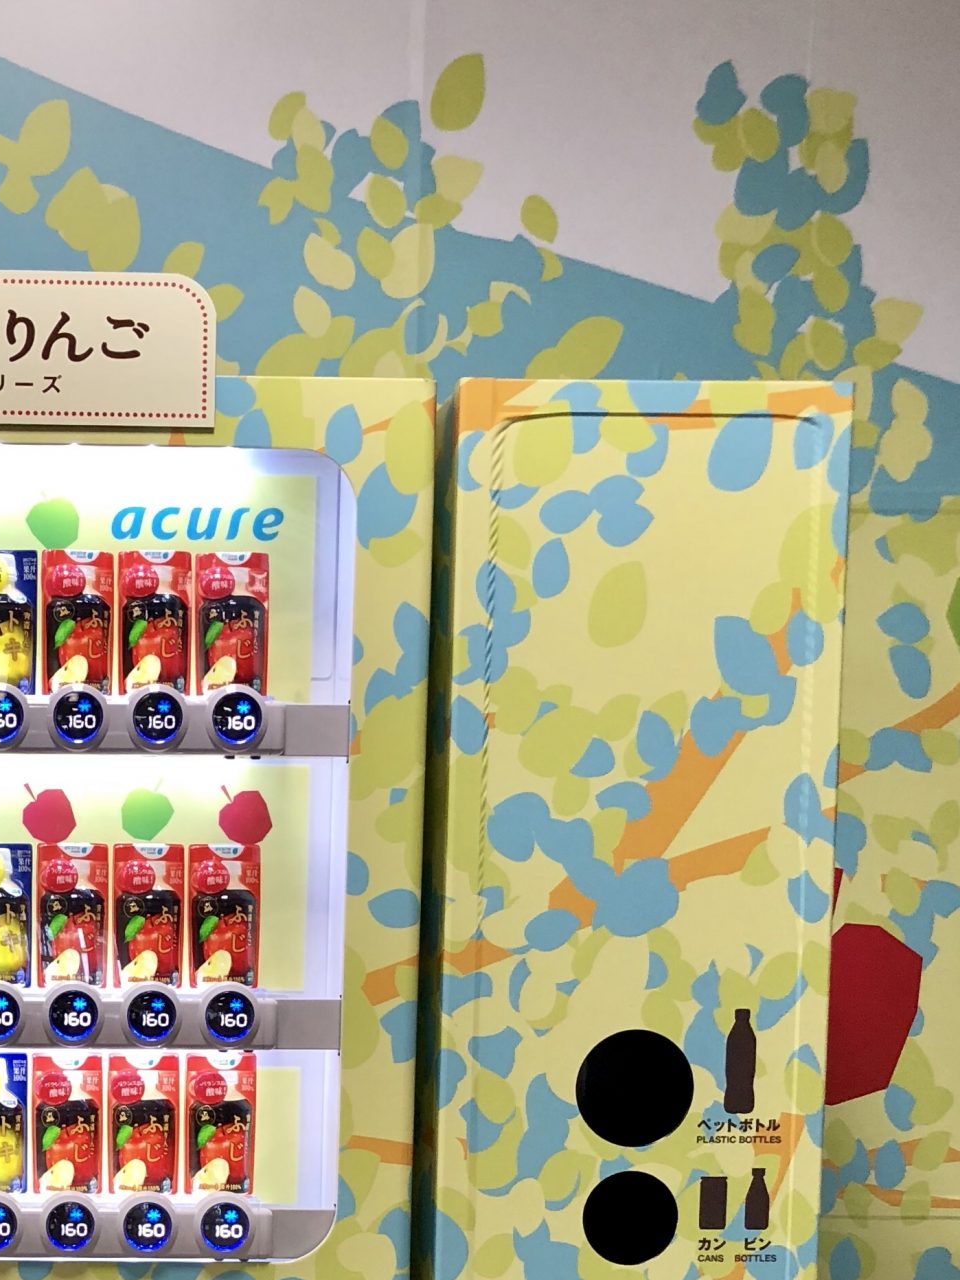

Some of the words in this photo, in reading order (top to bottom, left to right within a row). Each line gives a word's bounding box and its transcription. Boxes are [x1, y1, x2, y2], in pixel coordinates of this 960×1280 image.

[111, 507, 284, 541] acure
[4, 611, 21, 661] トキ
[69, 715, 96, 729] 160
[148, 716, 175, 729] 160
[227, 716, 255, 730] 160
[64, 1013, 91, 1026] 160
[142, 1014, 169, 1027] 160
[220, 1014, 247, 1027] 160
[698, 1119, 780, 1132] ペットボトル
[697, 1136, 736, 1144] PLASTIC
[739, 1136, 781, 1144] BOTTLES
[61, 1223, 88, 1236] 160
[138, 1224, 166, 1237] 160
[216, 1224, 243, 1238] 160
[698, 1238, 726, 1251] カン
[744, 1237, 771, 1251] ビン
